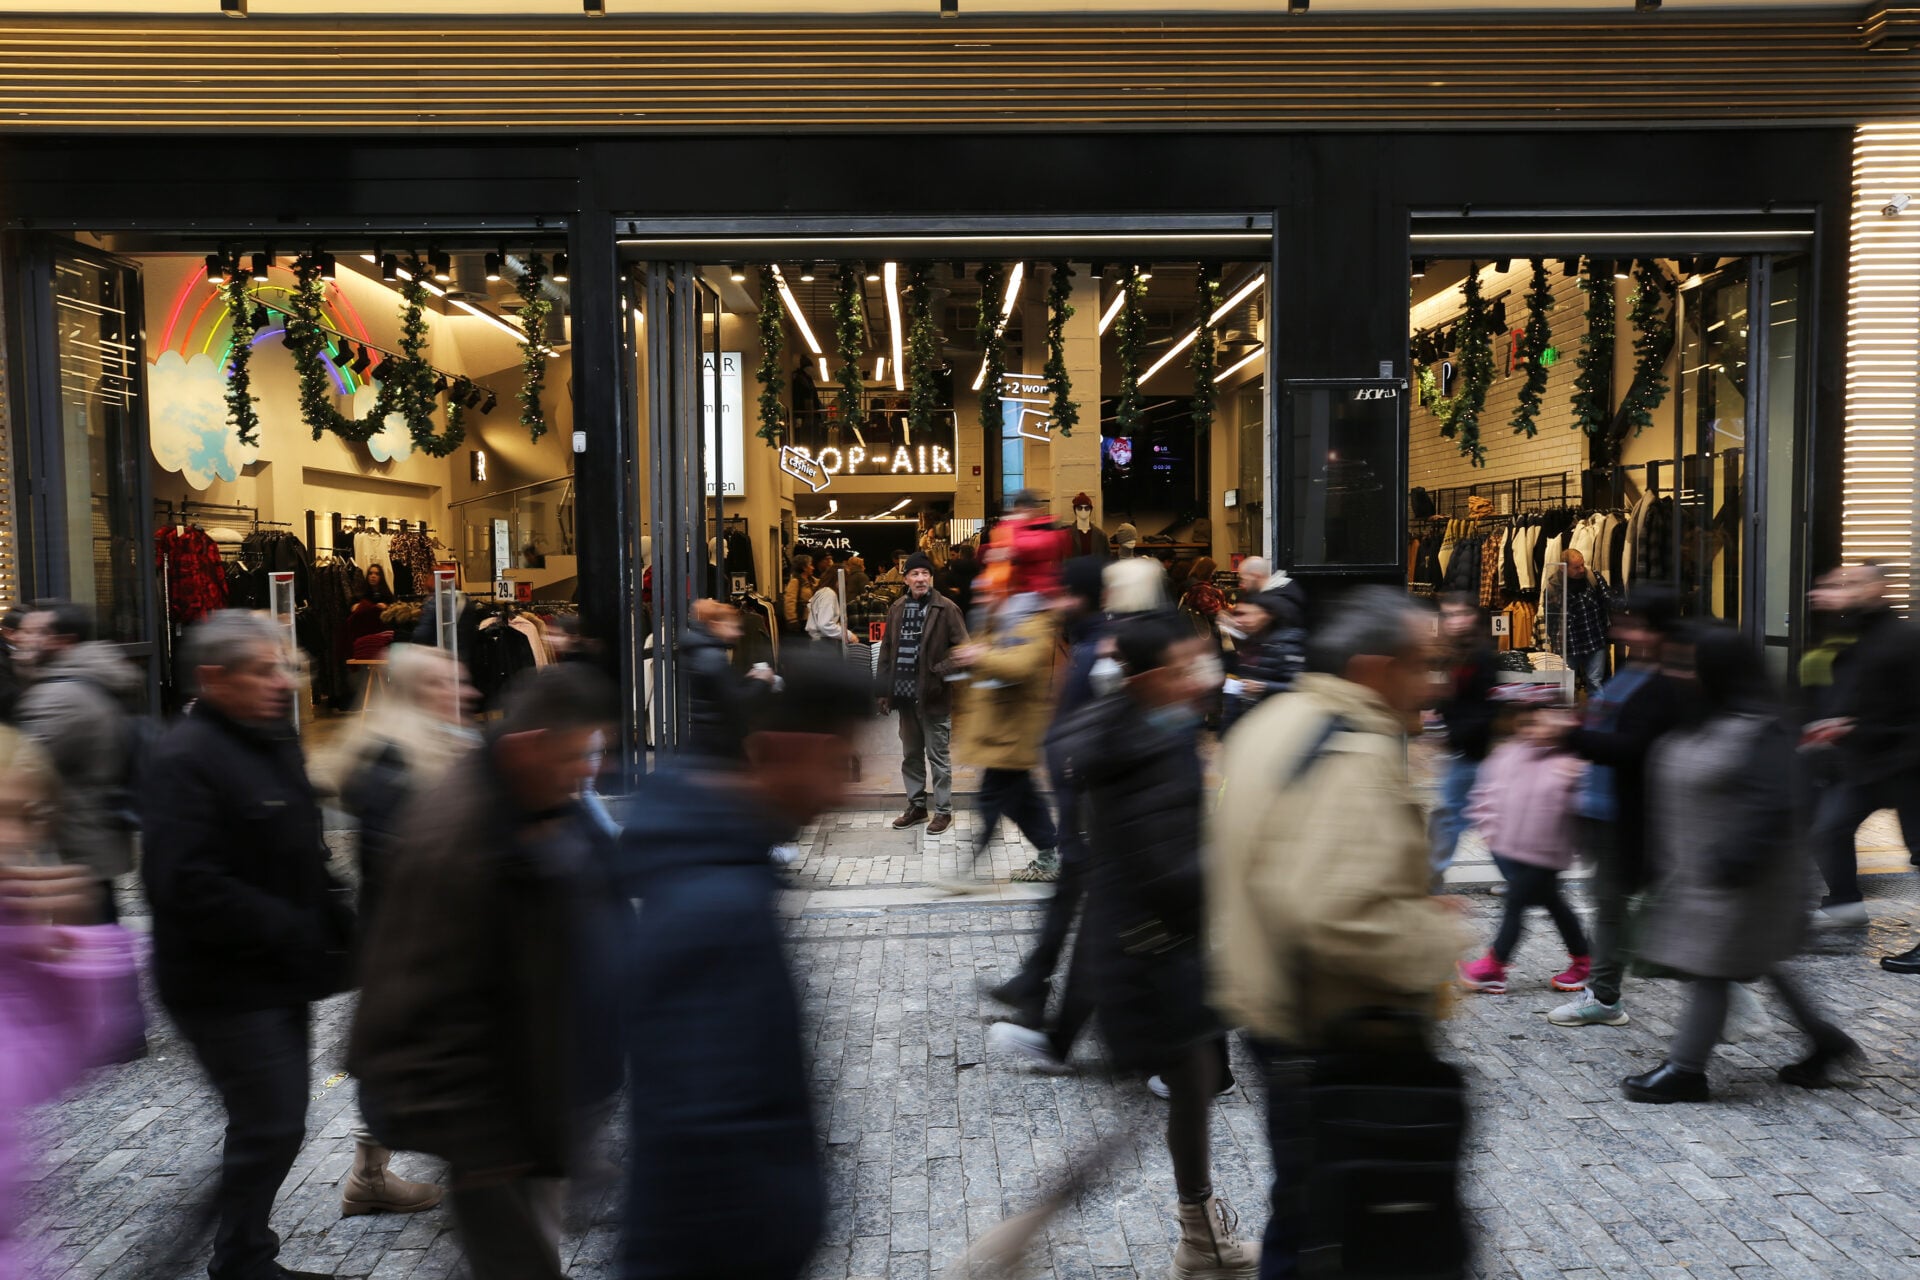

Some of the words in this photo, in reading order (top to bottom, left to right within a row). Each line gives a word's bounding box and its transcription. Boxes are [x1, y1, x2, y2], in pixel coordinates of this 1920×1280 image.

[704, 358, 735, 372] AR
[1004, 382, 1020, 394] +2
[704, 403, 730, 413] mn
[788, 456, 818, 479] cashier
